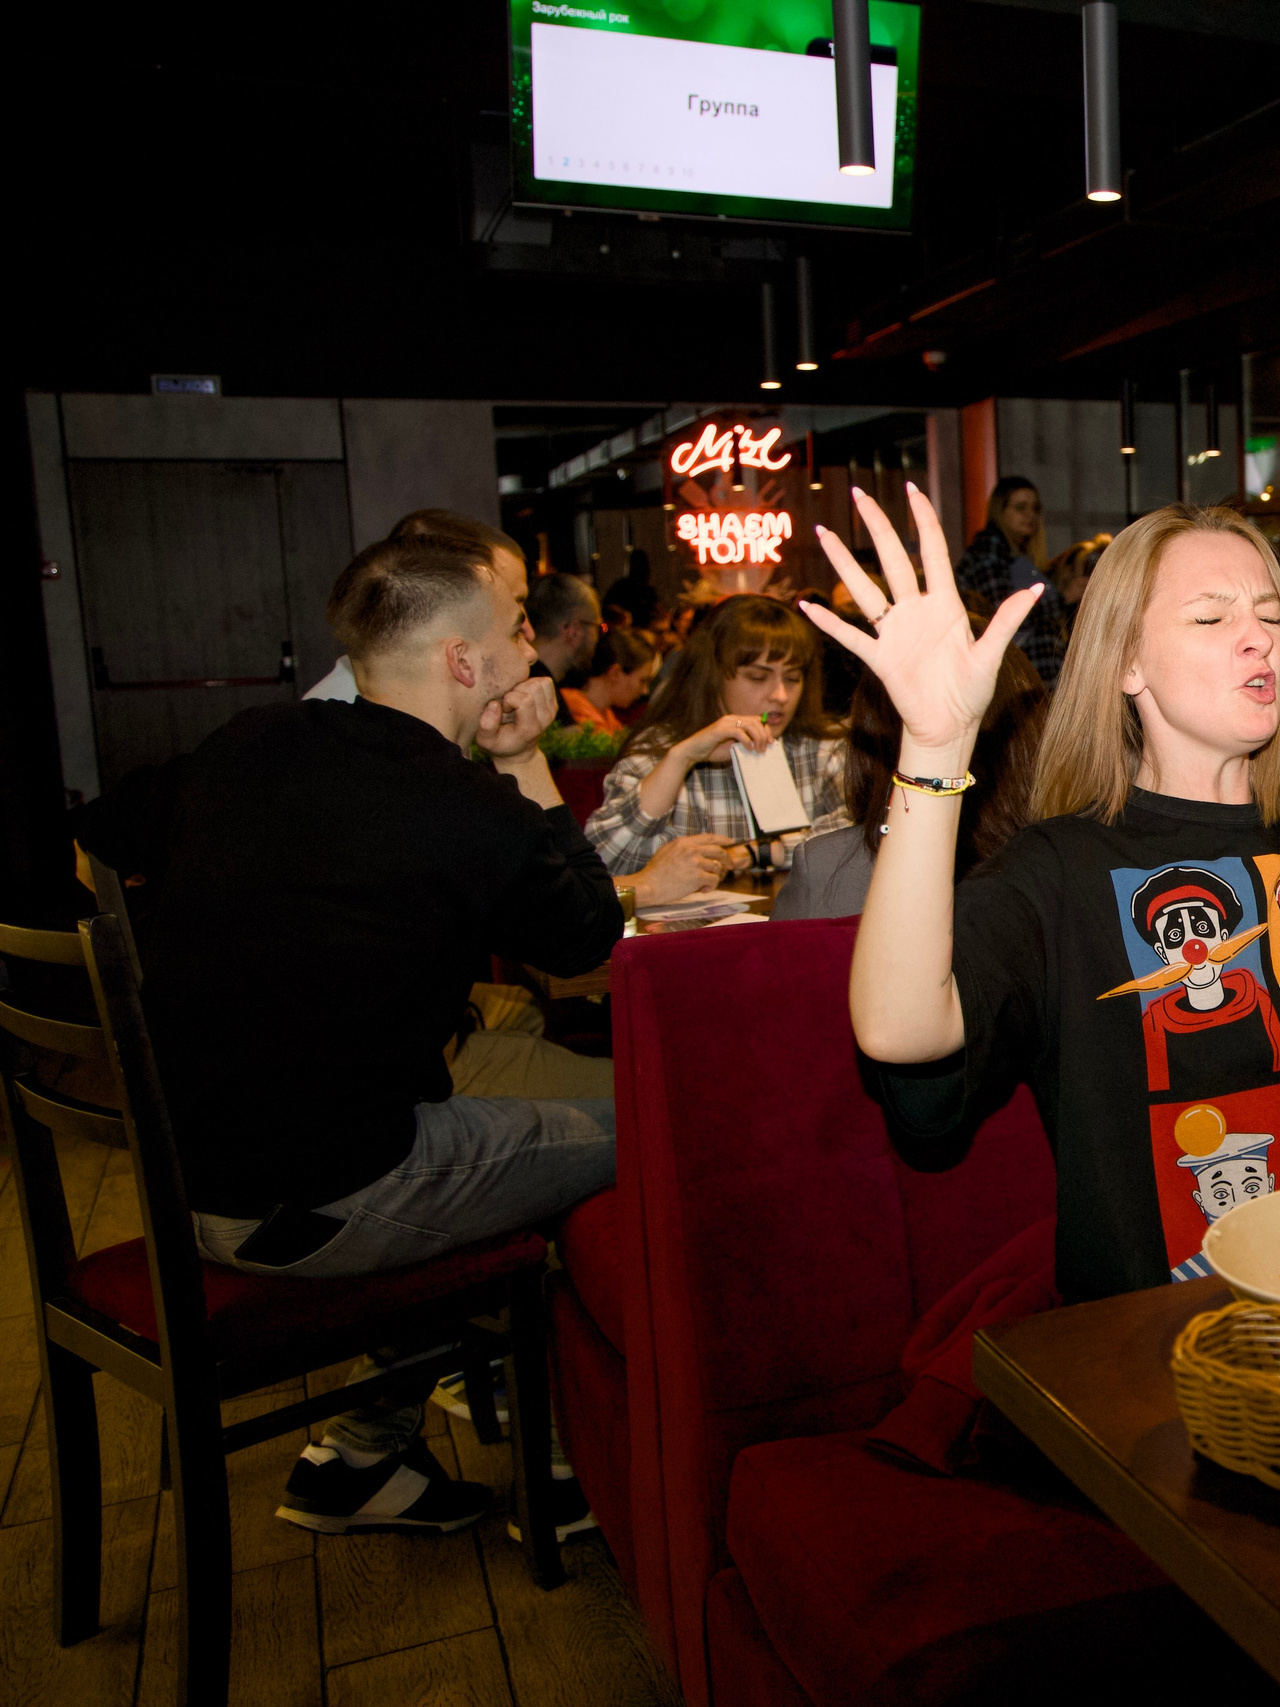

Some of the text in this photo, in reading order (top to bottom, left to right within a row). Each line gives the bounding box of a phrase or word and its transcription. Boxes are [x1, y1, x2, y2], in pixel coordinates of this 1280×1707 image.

[532, 1, 630, 24] Зарубежный рок
[688, 94, 759, 117] Группа
[677, 511, 793, 540] ЗНАЕМ
[690, 536, 783, 565] ТОЛК
